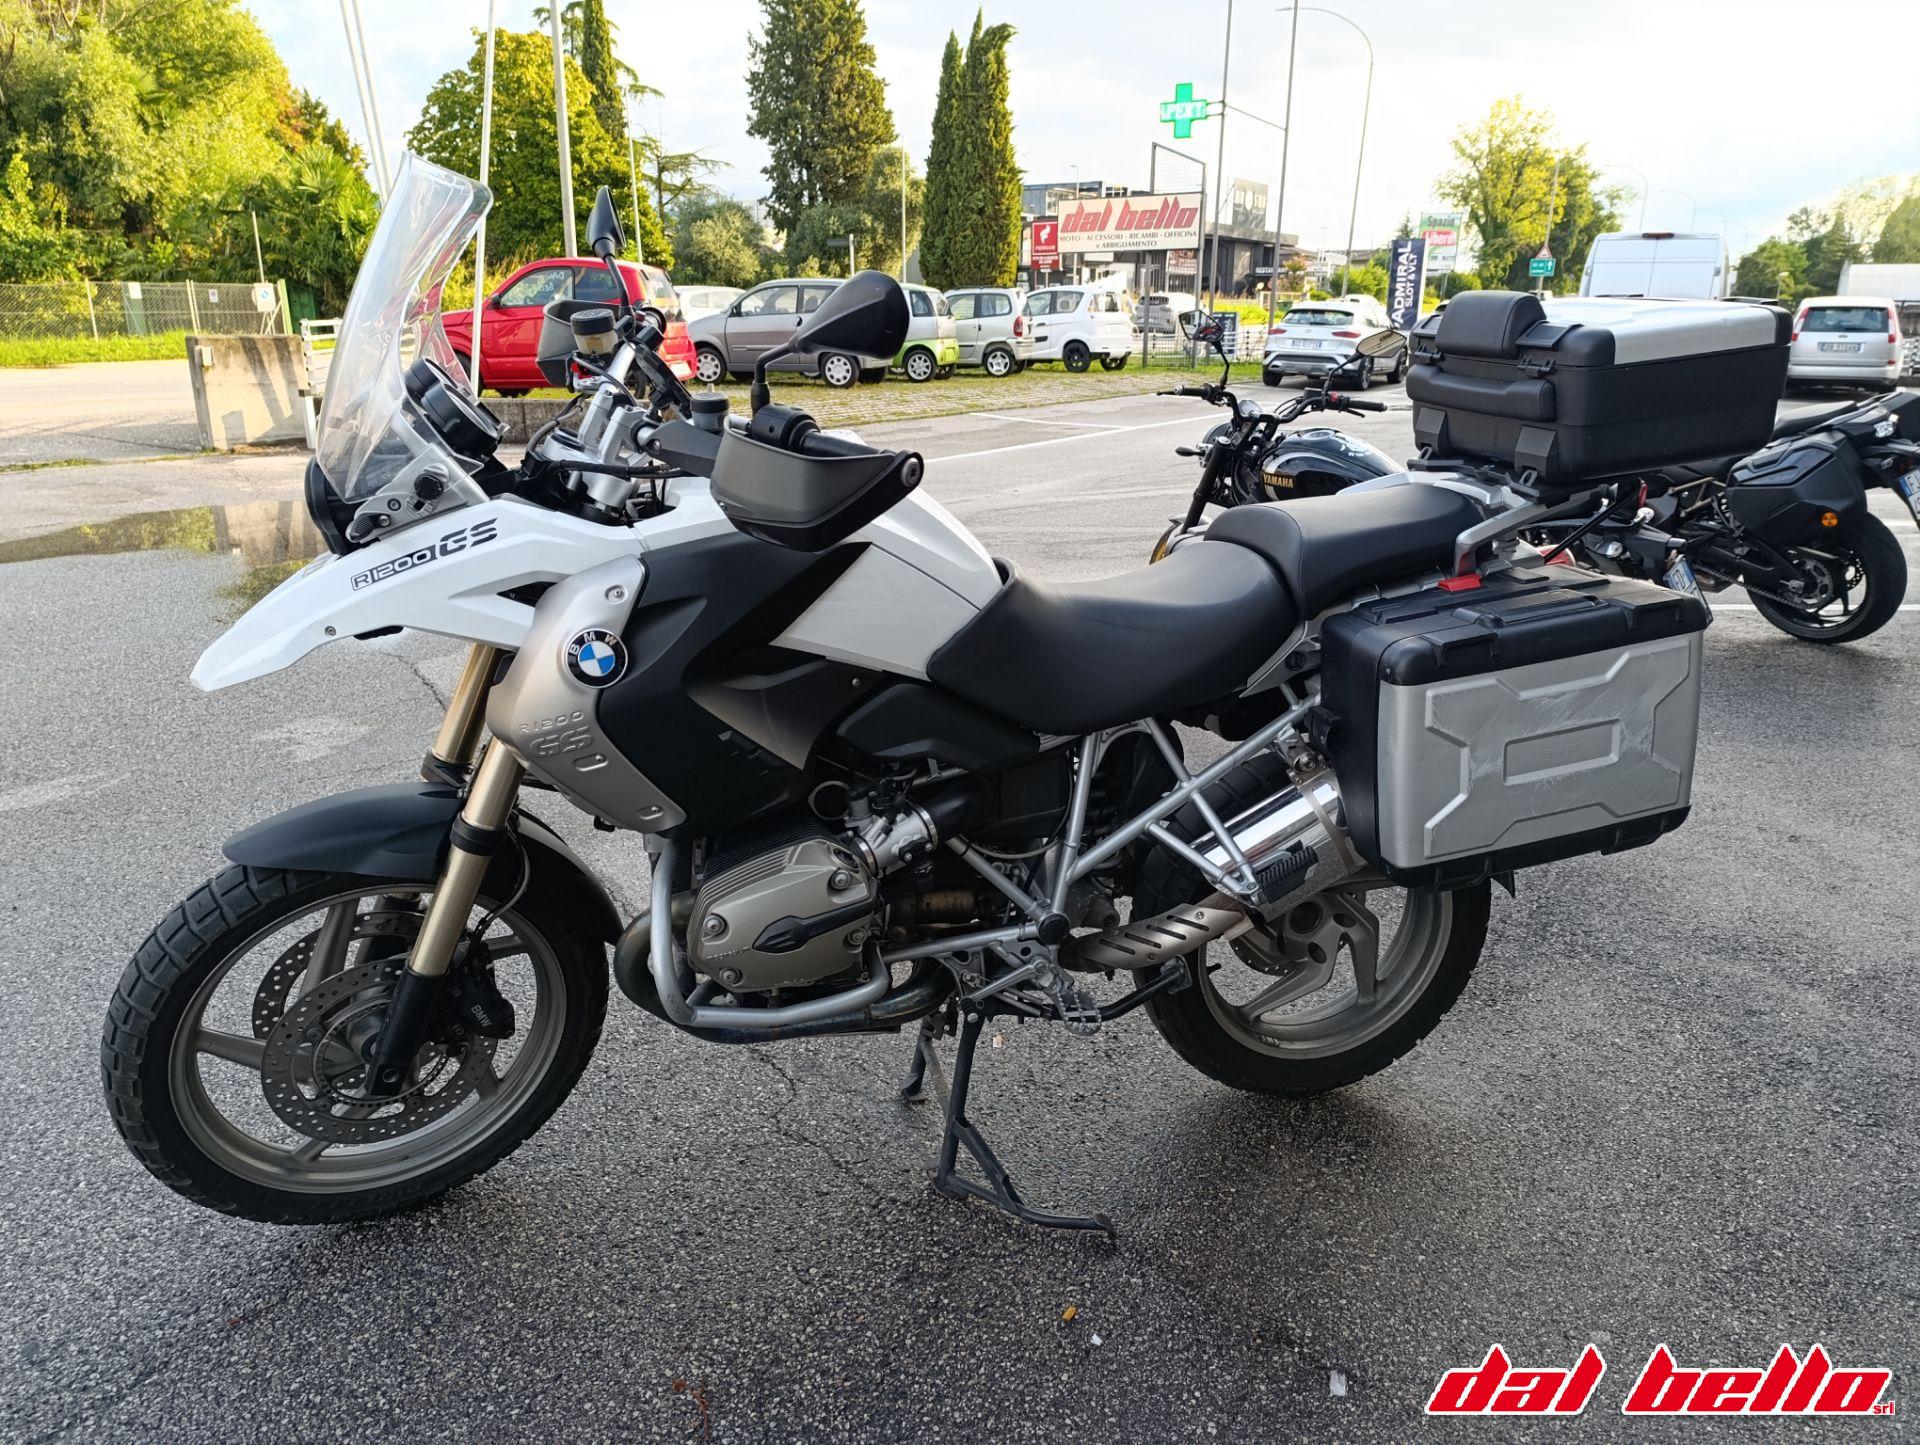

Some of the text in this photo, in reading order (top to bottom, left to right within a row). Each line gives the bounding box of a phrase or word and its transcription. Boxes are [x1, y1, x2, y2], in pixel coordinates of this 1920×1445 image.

[1060, 195, 1199, 233] dal bello
[1427, 215, 1455, 229] Spazio
[1086, 233, 1124, 241] ACCESSORI
[1164, 230, 1197, 238] OFFICINA
[1102, 240, 1157, 249] ABBIGLIAMENTO
[1408, 253, 1418, 273] VLT
[1405, 281, 1415, 307] SLOT
[1264, 473, 1294, 489] YAMAHA
[569, 631, 618, 656] BMW
[529, 725, 592, 758] GS
[471, 1004, 492, 1027] BMW
